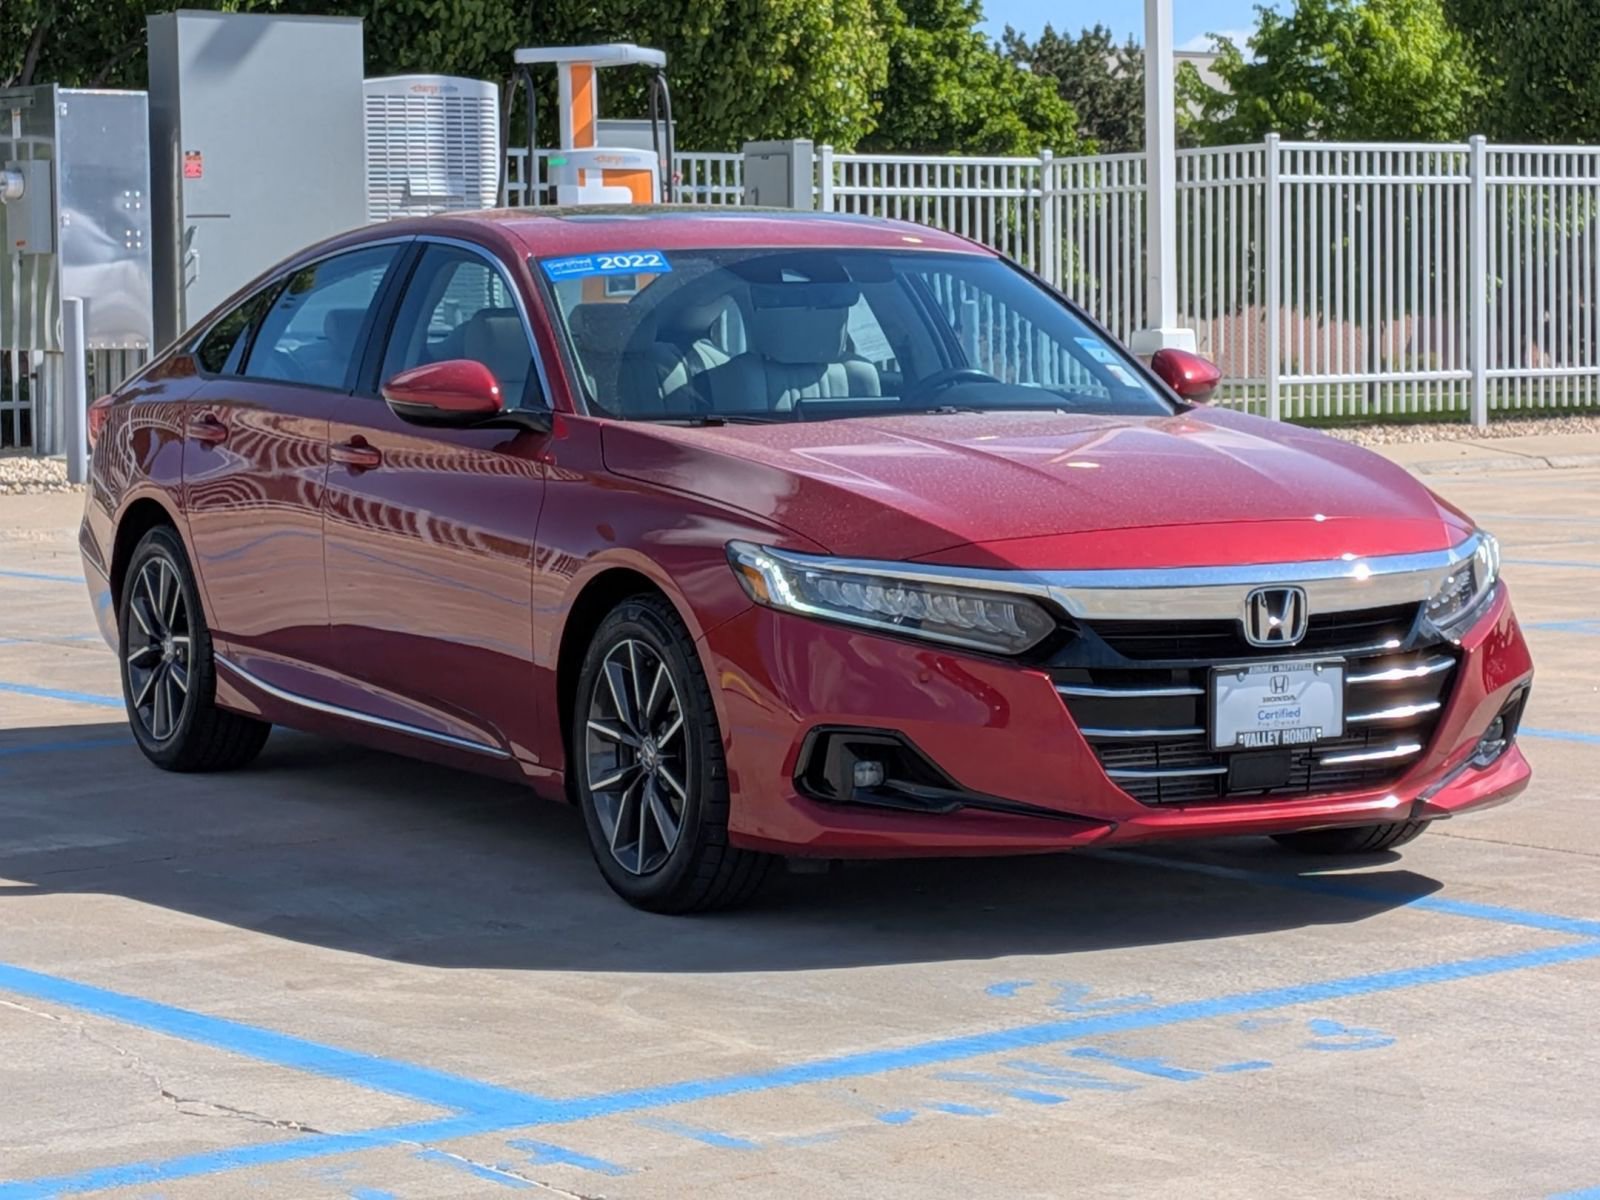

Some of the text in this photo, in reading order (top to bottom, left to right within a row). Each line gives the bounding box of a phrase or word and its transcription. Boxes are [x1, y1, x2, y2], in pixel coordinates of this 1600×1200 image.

[597, 254, 663, 269] 2022
[1262, 694, 1297, 703] HONDA
[1257, 708, 1301, 721] Certified
[1244, 728, 1318, 748] VALLEY HONDA
